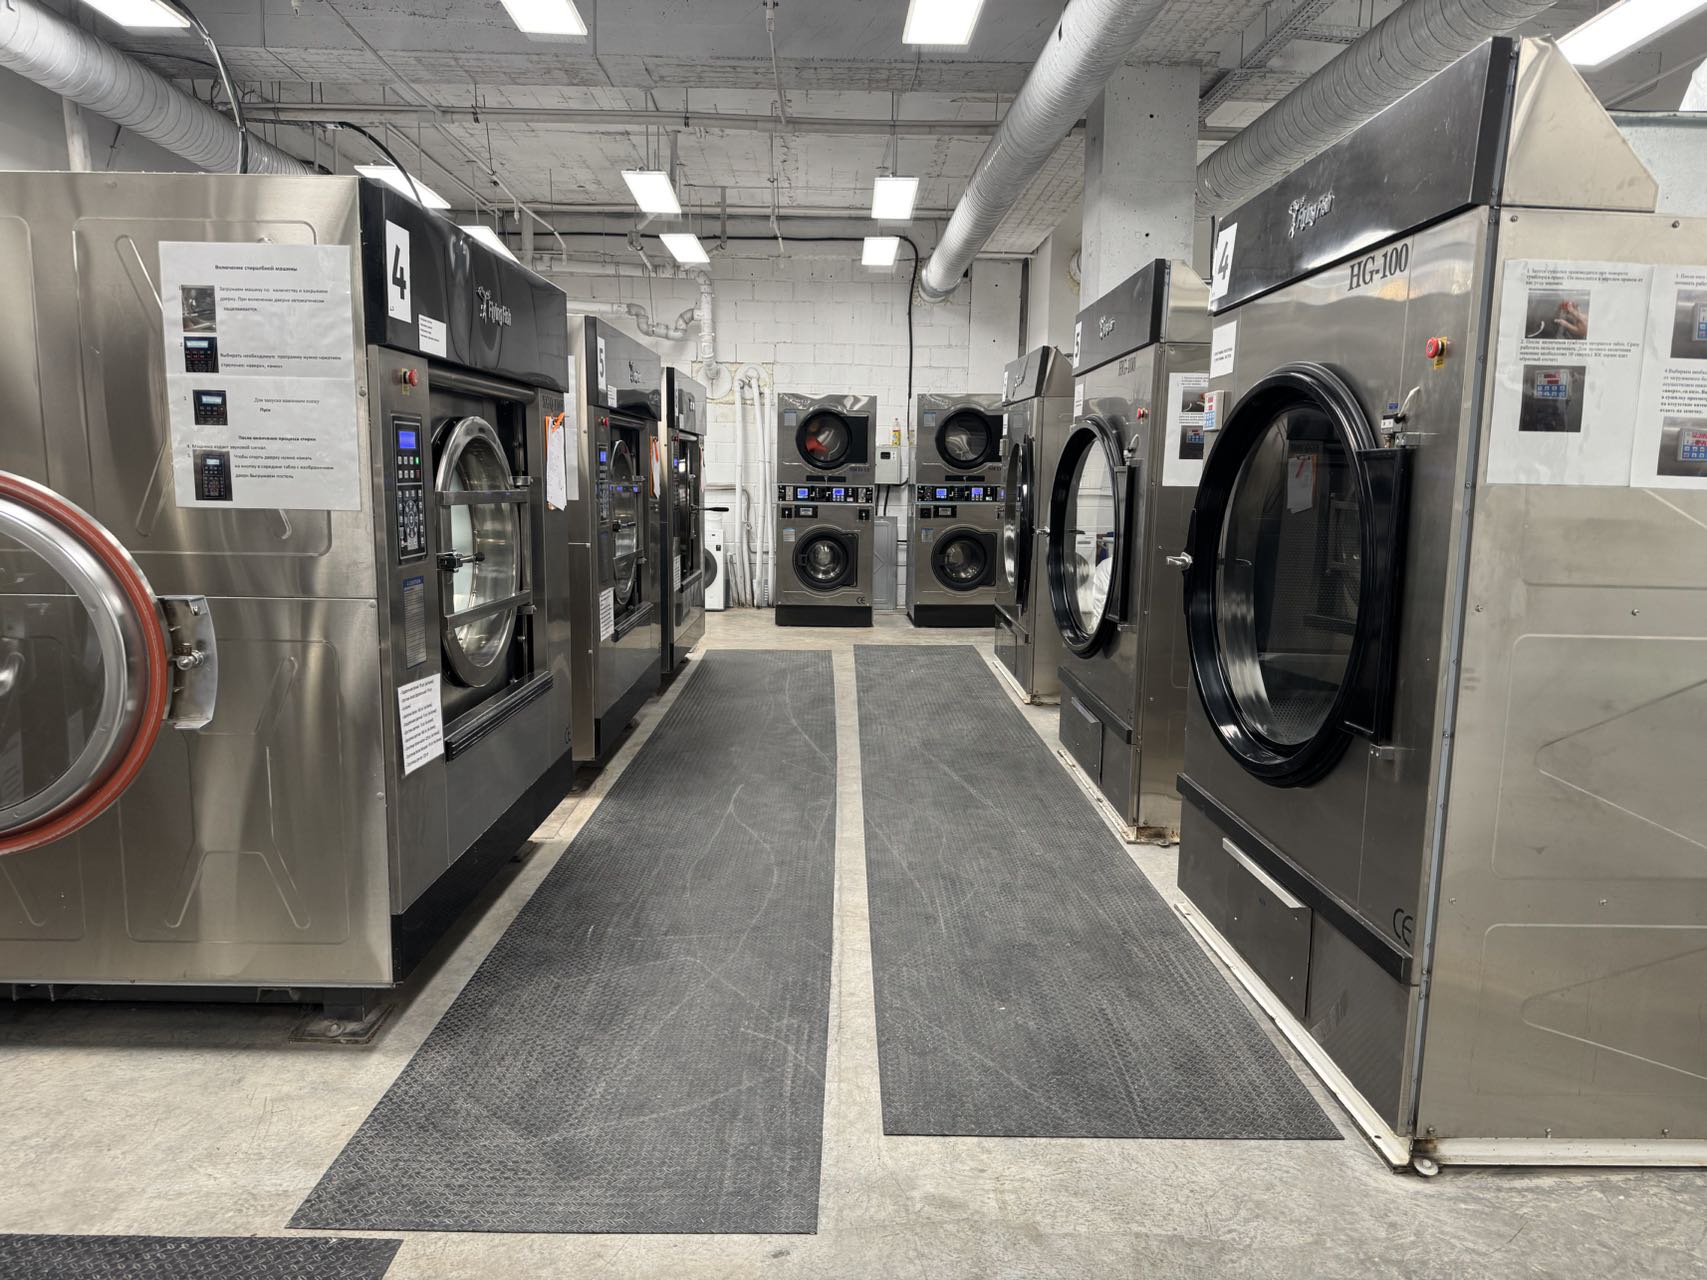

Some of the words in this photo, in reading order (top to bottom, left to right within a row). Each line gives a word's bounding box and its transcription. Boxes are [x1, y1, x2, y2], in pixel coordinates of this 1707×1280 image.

[392, 244, 407, 300] 4
[1217, 241, 1229, 280] 4
[1347, 243, 1410, 292] HG-100
[598, 348, 605, 379] 5
